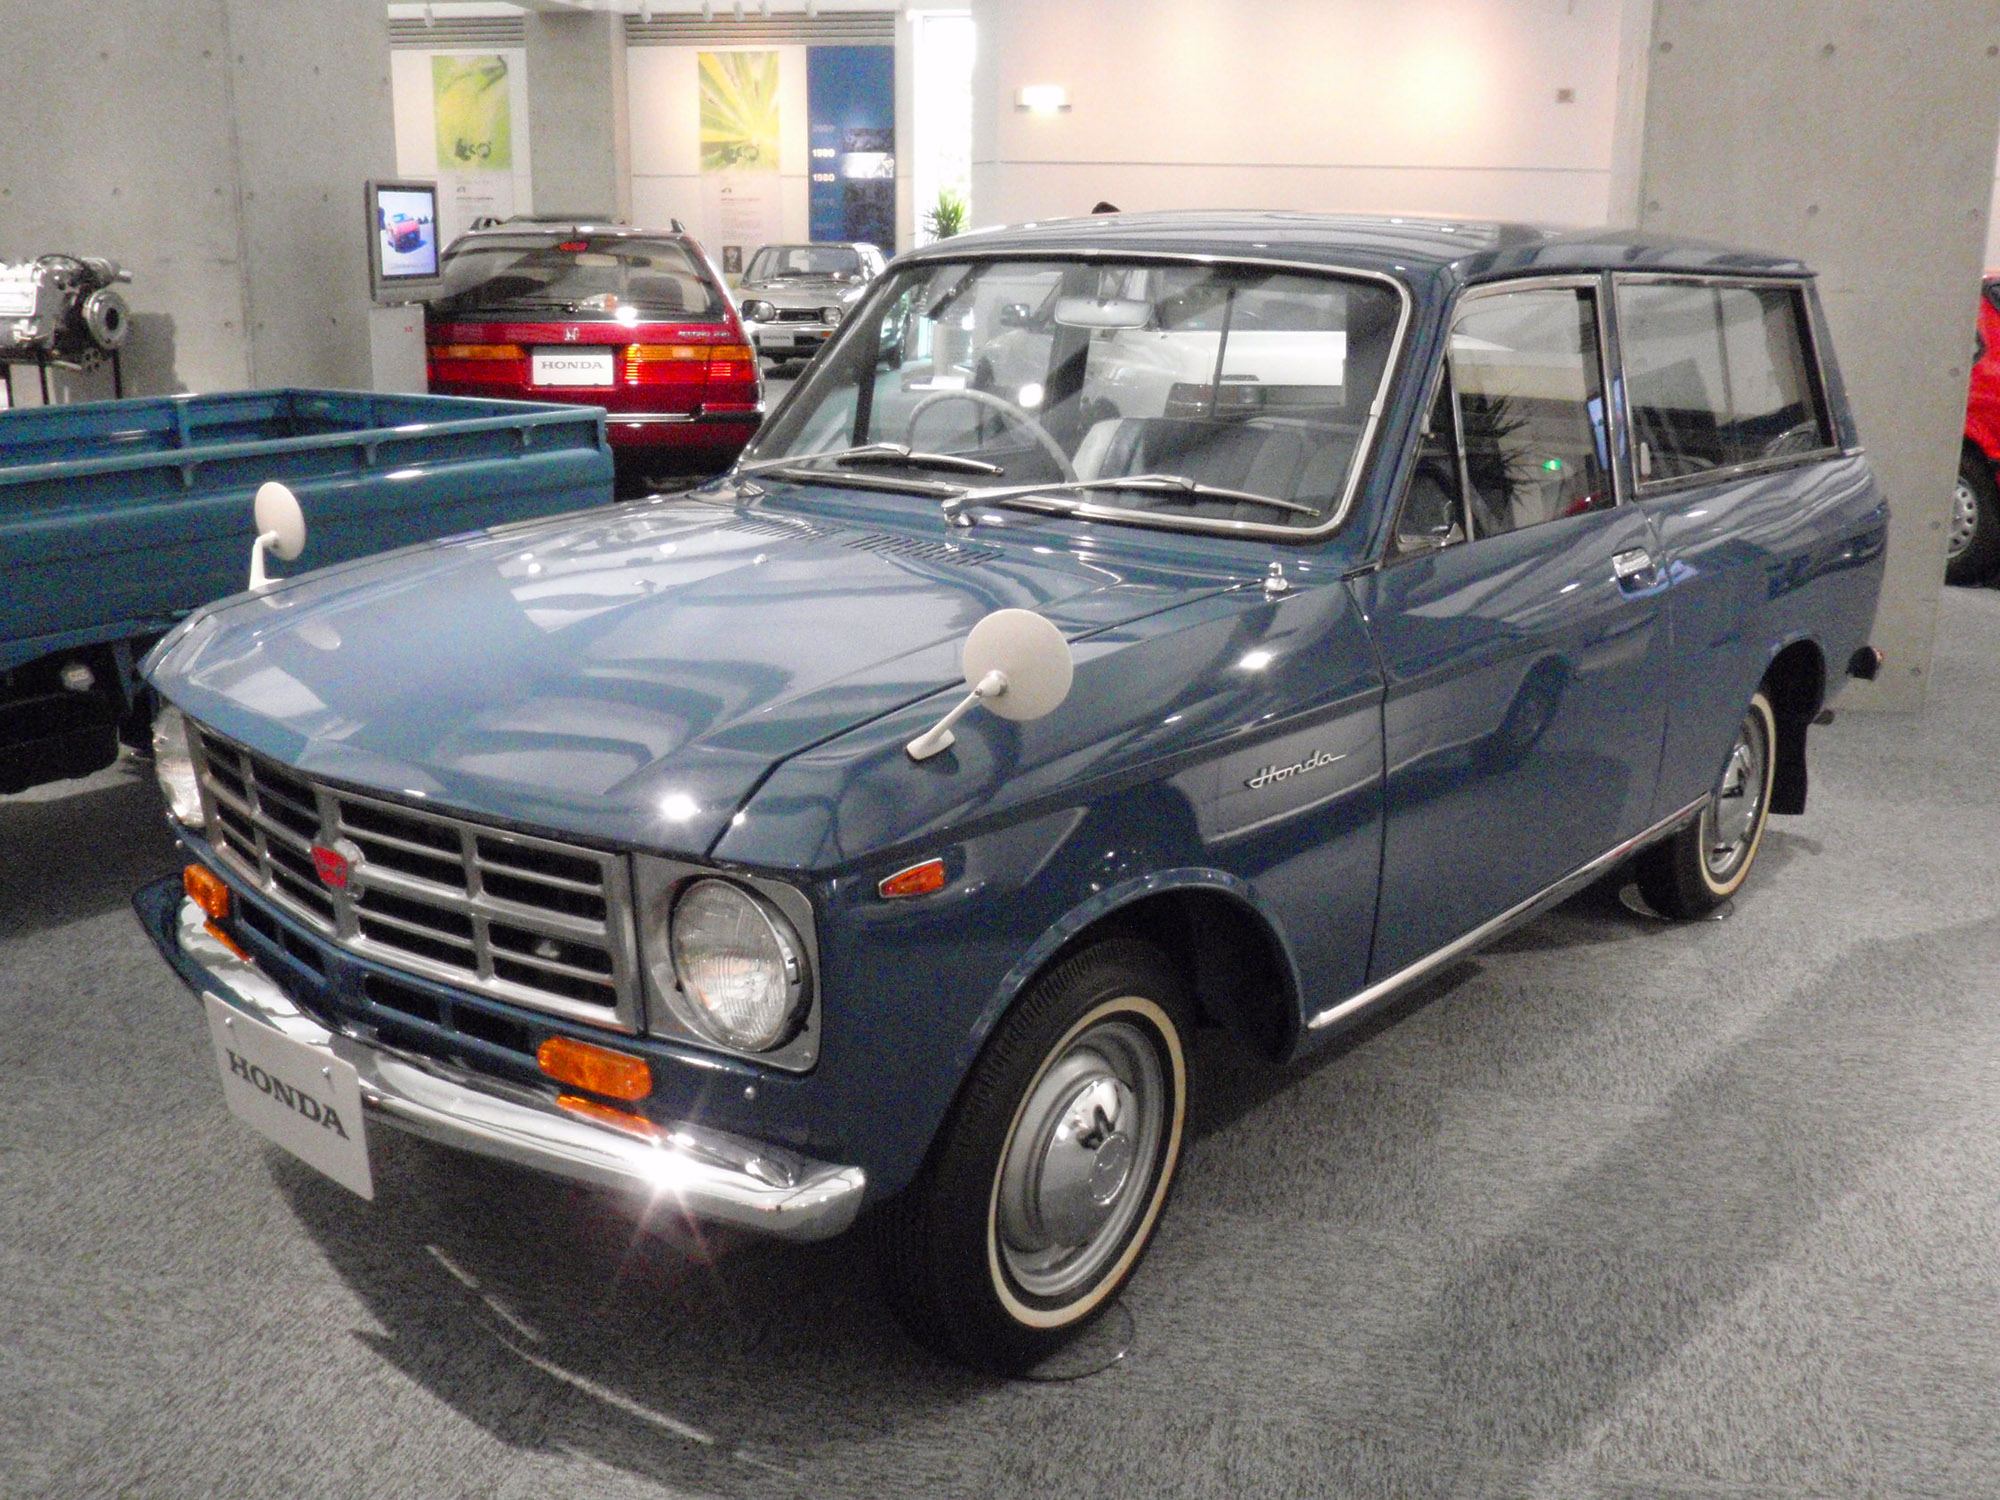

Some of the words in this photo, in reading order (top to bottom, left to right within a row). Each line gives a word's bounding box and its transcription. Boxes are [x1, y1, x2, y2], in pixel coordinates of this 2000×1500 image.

[541, 361, 603, 370] HONDA
[1248, 750, 1346, 789] Honda
[226, 1048, 350, 1141] HONDA
